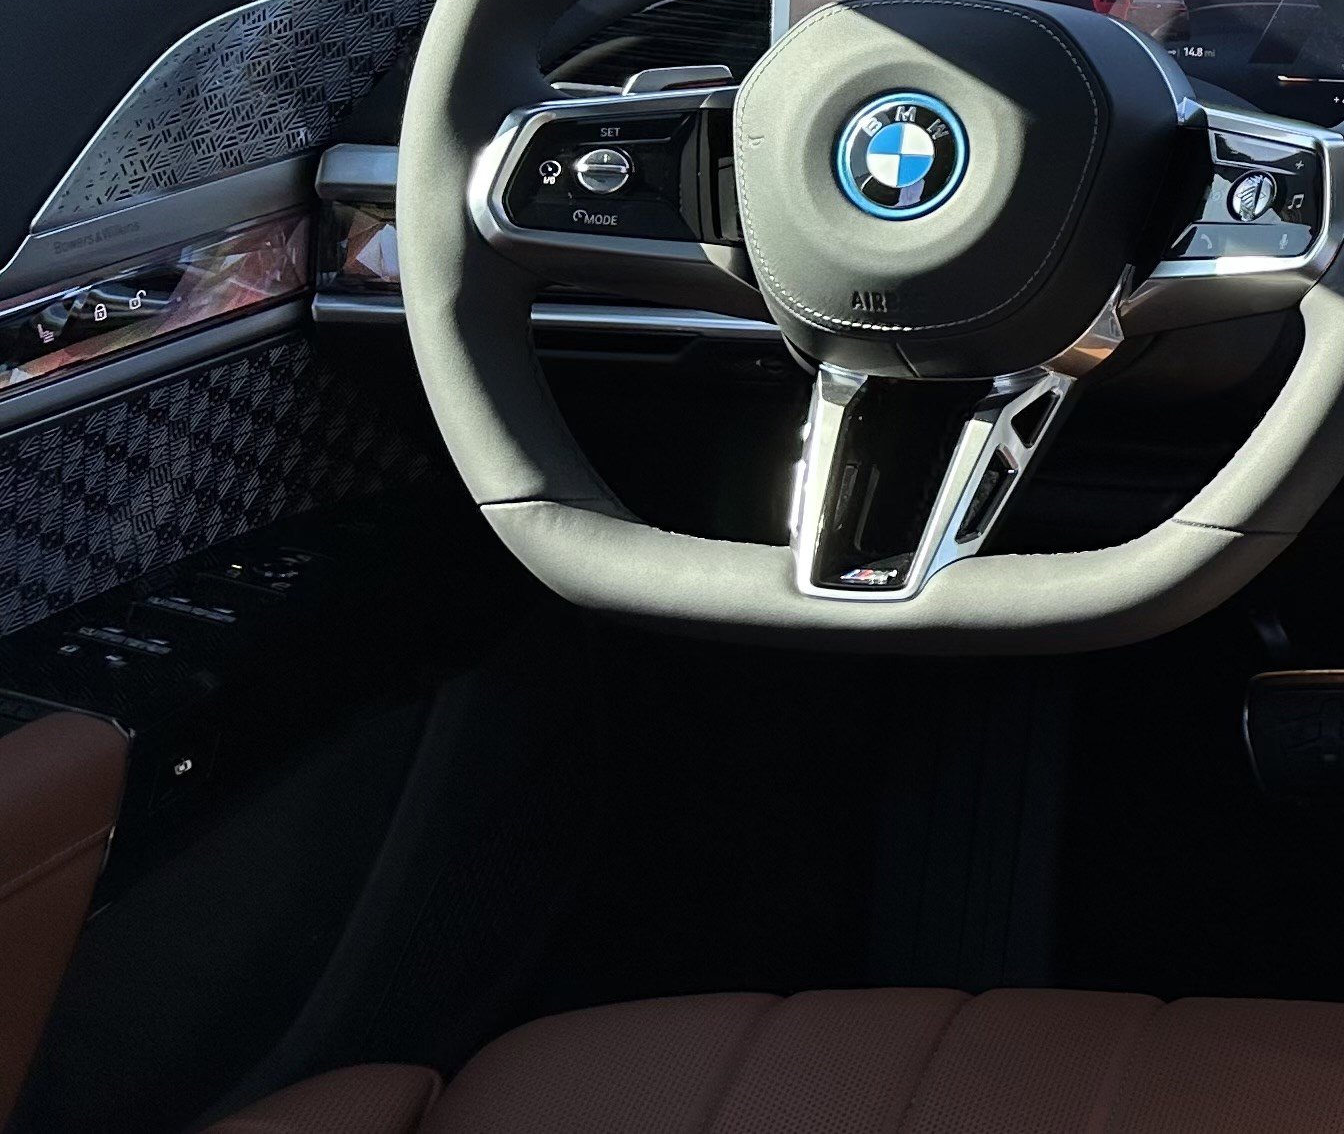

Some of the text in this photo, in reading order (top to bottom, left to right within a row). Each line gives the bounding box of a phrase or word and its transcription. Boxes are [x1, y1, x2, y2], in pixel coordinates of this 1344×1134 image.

[1183, 46, 1216, 58] 14.8 mi
[861, 105, 950, 141] BMW
[600, 127, 621, 138] SET
[584, 214, 618, 226] MODE
